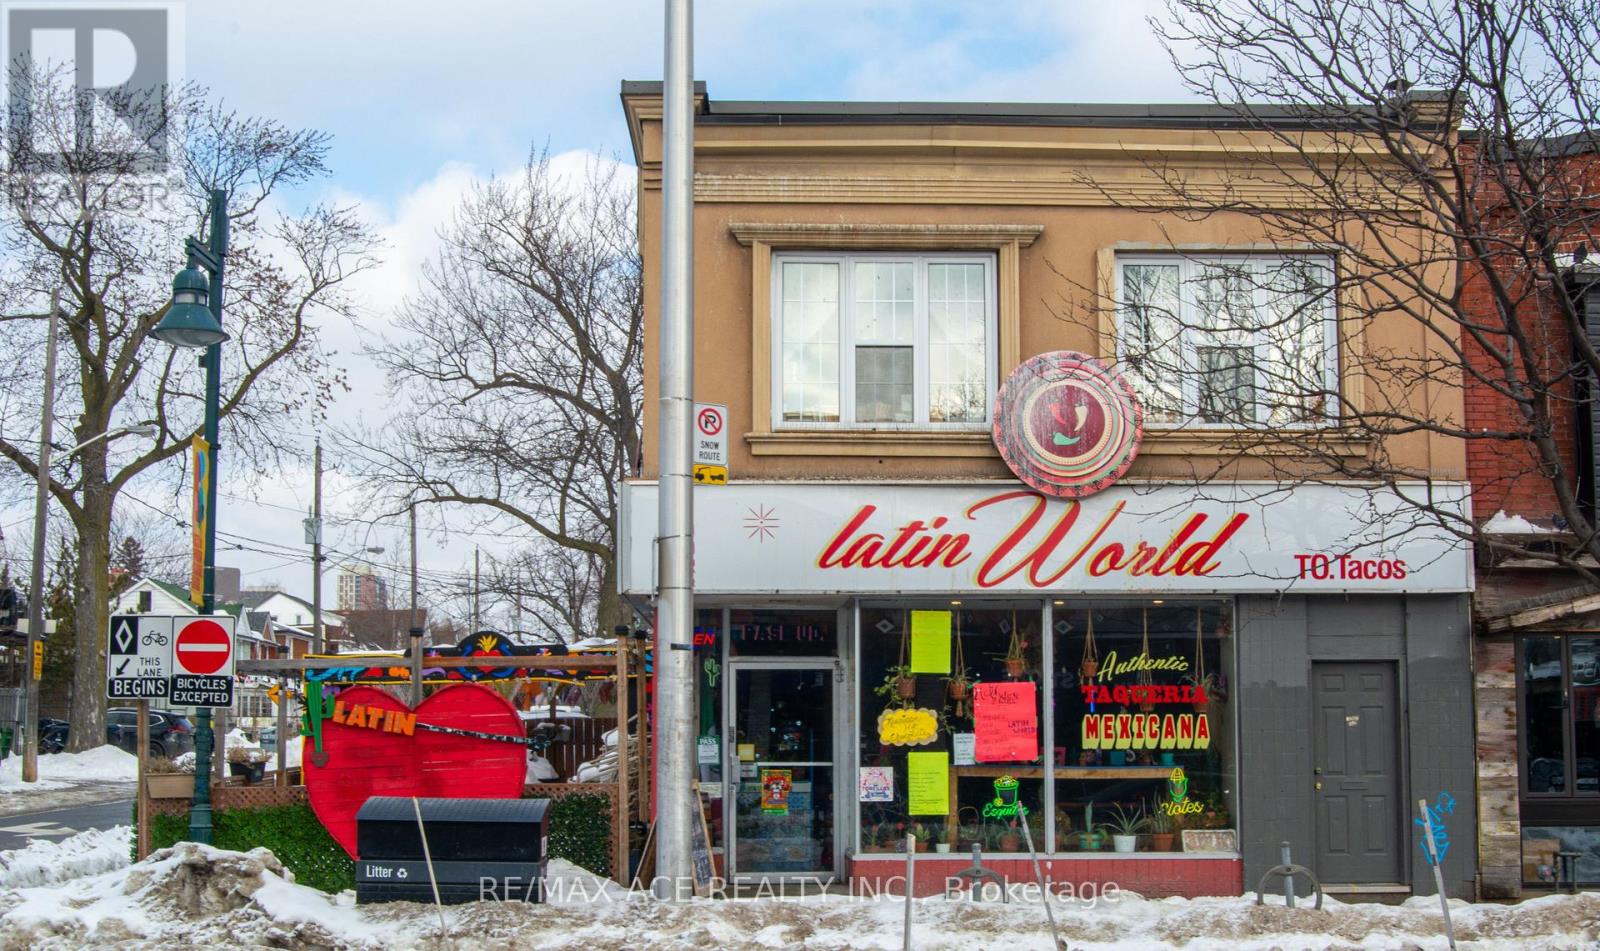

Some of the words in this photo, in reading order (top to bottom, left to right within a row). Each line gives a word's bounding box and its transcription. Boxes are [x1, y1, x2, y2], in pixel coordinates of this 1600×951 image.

[700, 440, 720, 450] SNOW
[699, 451, 721, 461] ROUTE
[964, 490, 1250, 589] World
[140, 657, 161, 665] THIS
[1097, 650, 1189, 682] Authentic
[137, 668, 163, 677] LANE
[114, 679, 166, 695] BEGINS
[176, 678, 227, 690] BICYCLES
[173, 691, 229, 703] EXCEPTED
[1081, 684, 1209, 707] TAQUERIA
[332, 700, 417, 736] LATIN
[1082, 713, 1211, 750] MEXICANA
[699, 737, 717, 745] PASS
[982, 802, 1030, 820] Esquits
[366, 865, 393, 878] Litter
